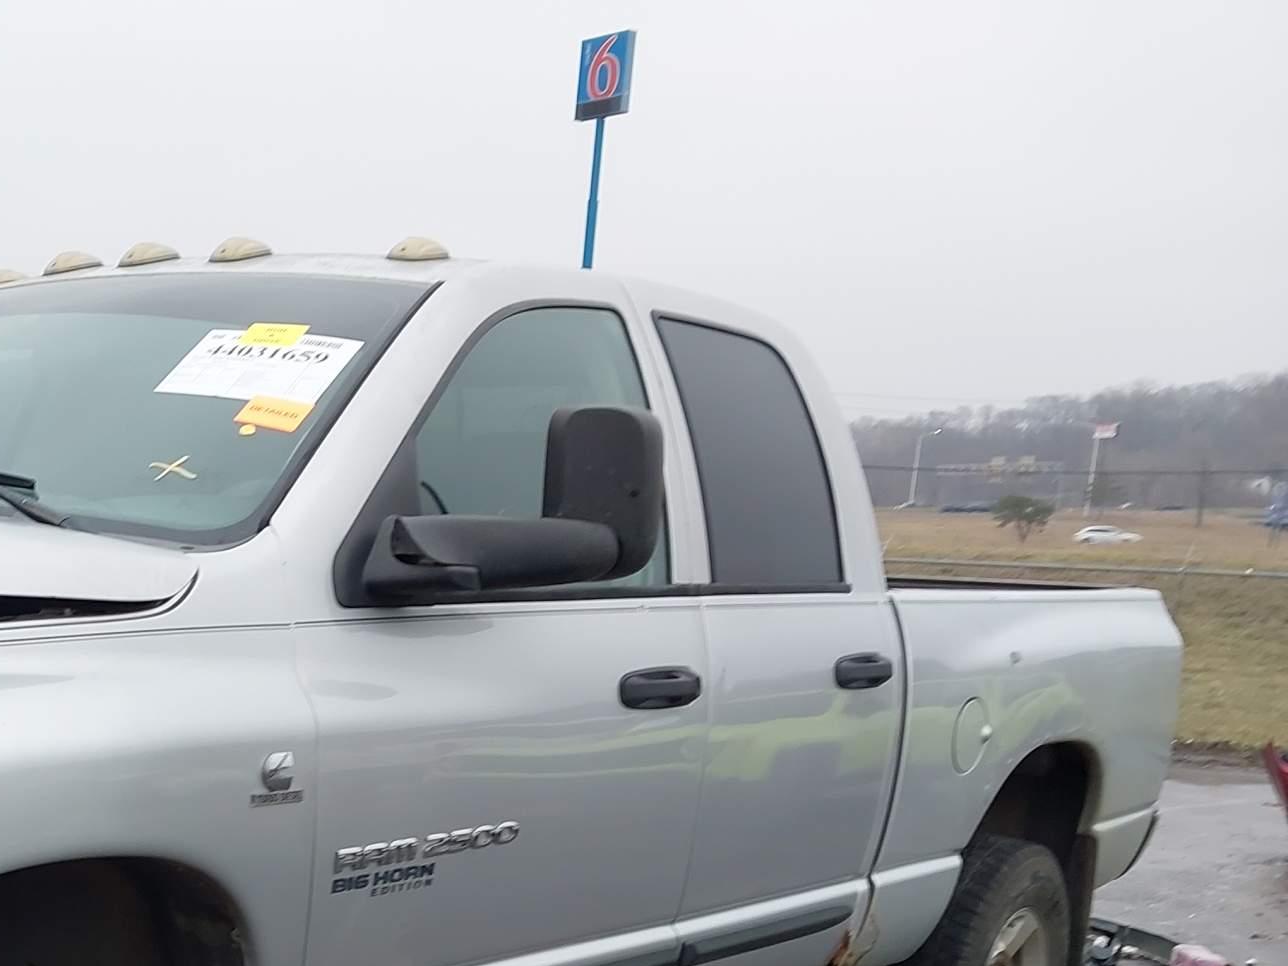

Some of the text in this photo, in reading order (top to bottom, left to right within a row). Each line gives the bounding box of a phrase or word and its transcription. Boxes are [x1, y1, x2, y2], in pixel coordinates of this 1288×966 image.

[587, 33, 620, 101] 6
[207, 343, 329, 363] 44031659
[333, 820, 521, 875] RAM 2500
[331, 862, 435, 894] BIG HORN
[370, 878, 434, 898] EDITION
